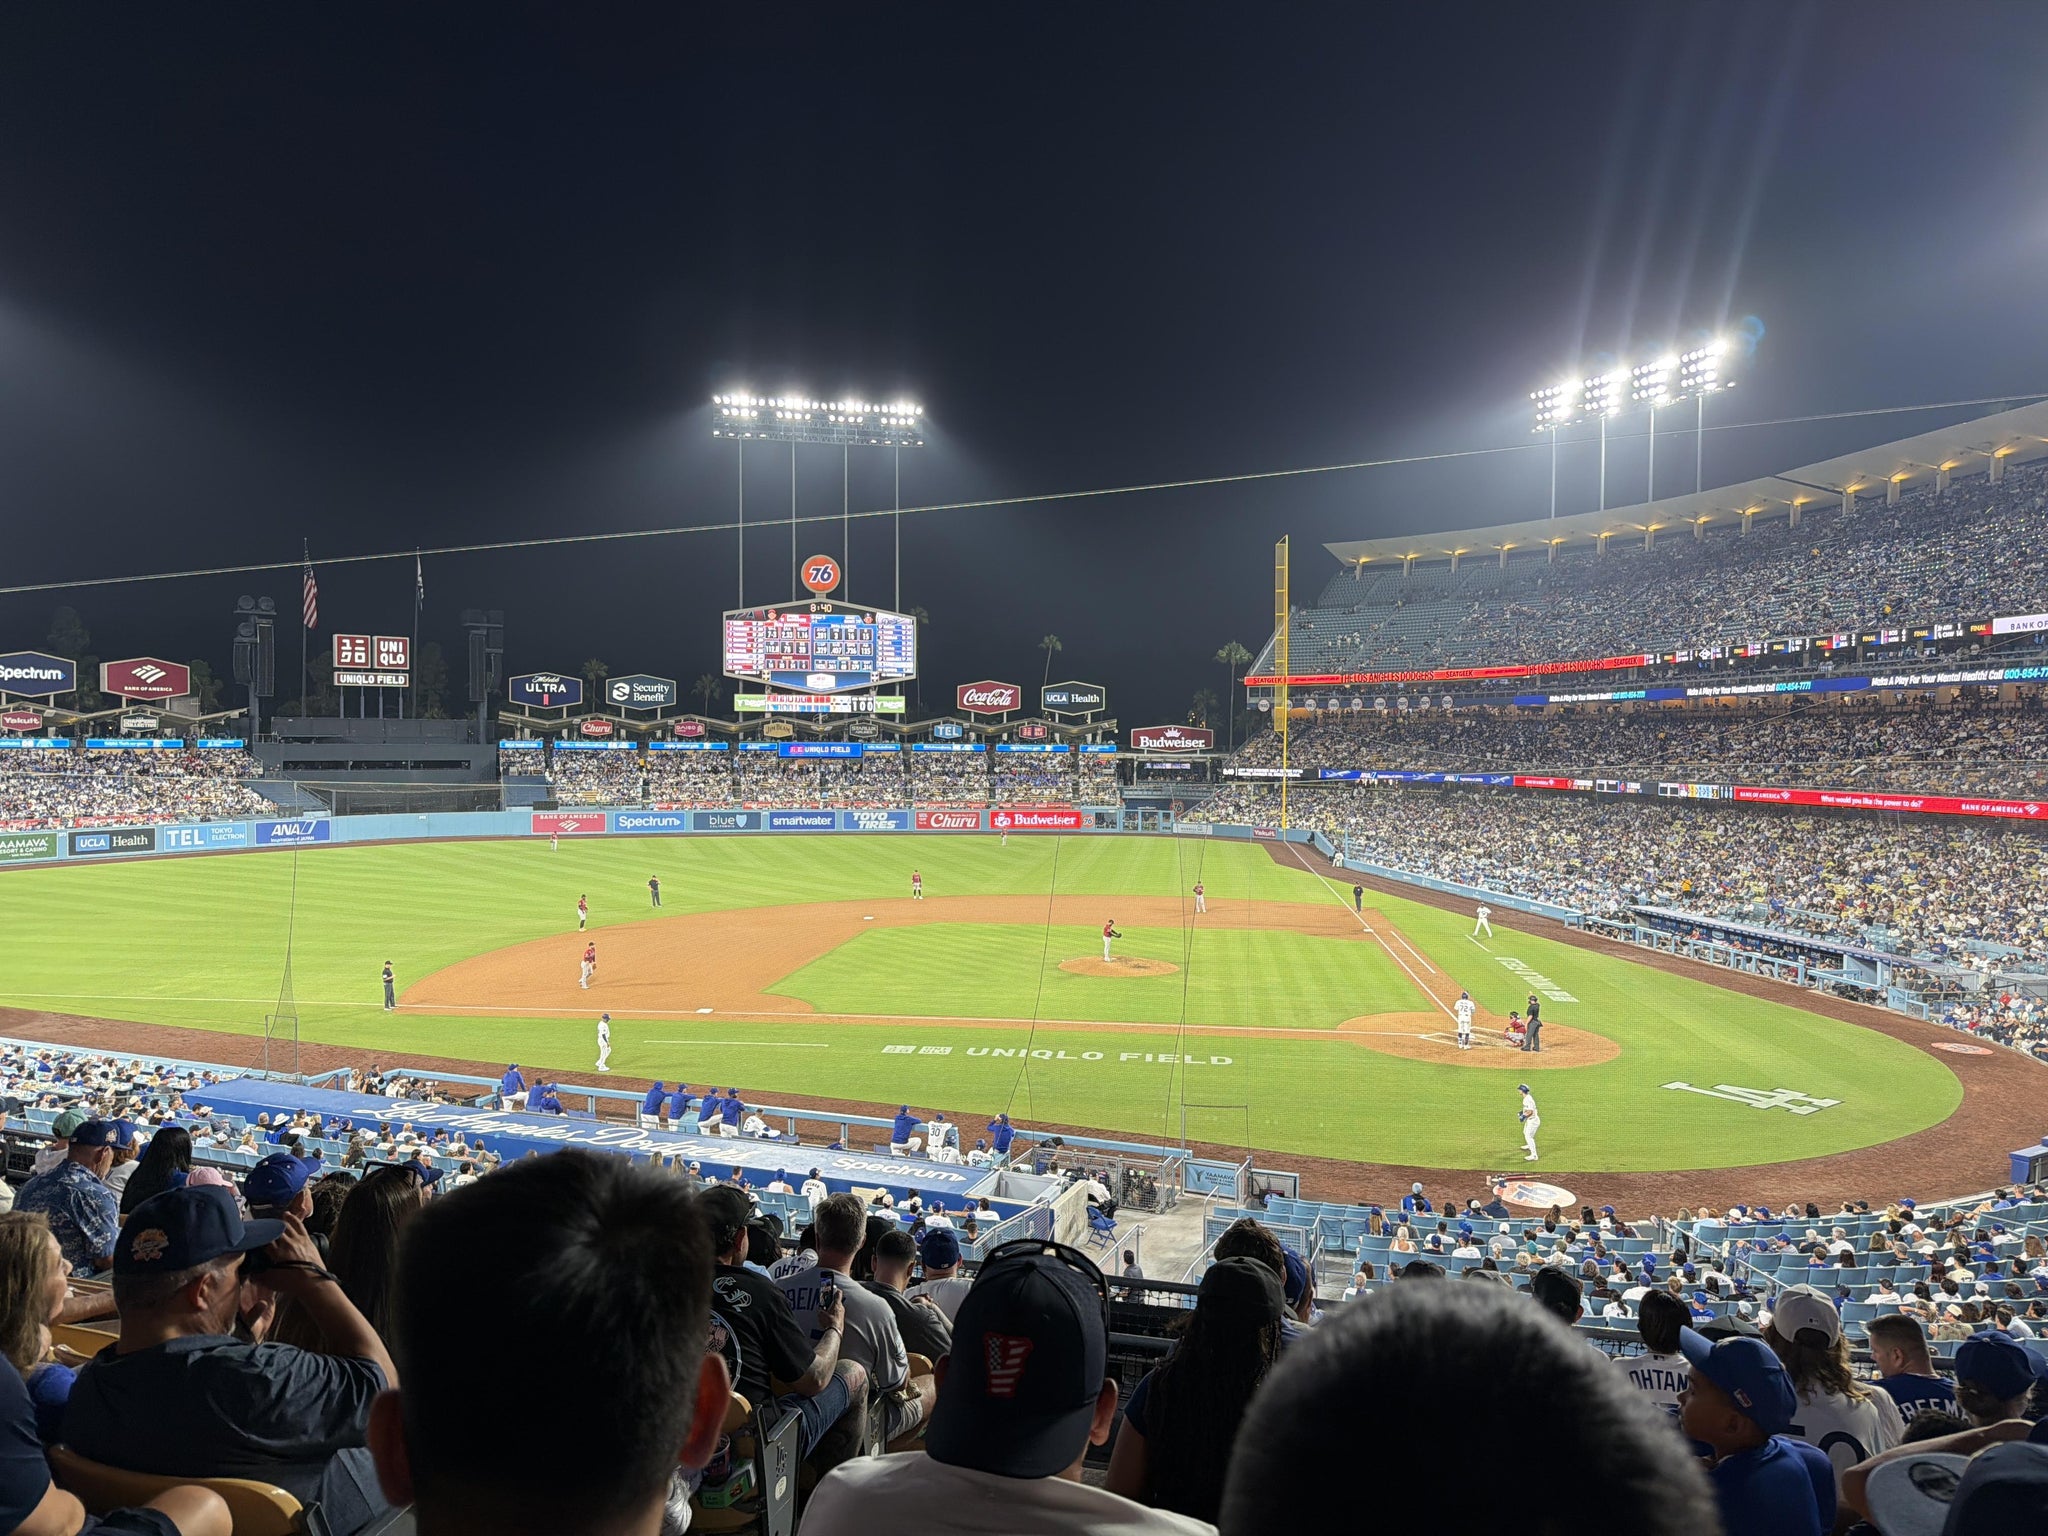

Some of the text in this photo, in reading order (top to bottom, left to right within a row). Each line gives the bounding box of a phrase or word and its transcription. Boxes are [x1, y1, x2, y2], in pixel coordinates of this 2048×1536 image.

[809, 564, 833, 584] 76
[810, 603, 832, 613] 8:40
[1970, 624, 1986, 632] FINAL
[2010, 620, 2048, 630] BANK OF
[380, 640, 403, 652] UNI
[380, 653, 405, 666] QLO
[1614, 655, 1638, 666] SEATGEEK
[1538, 664, 1550, 674] LOS
[1550, 662, 1577, 674] ANGELES
[1578, 660, 1604, 671] DODGERS
[0, 666, 62, 681] Spectrum
[1354, 672, 1367, 682] LOS
[1368, 672, 1400, 683] ANGELES
[1400, 670, 1434, 682] DODGERS
[1446, 670, 1473, 678] SEATGEEK
[1871, 668, 2004, 687] Make A Play For Your Mental Health! Call
[340, 674, 405, 685] UNIQLO FIELD
[526, 684, 566, 693] ULTRA
[633, 683, 670, 694] Security
[1703, 688, 1712, 696] Play
[1720, 686, 1731, 694] Your
[1765, 683, 1776, 692] Call
[633, 692, 665, 702] Benefit
[963, 688, 1014, 706] Coca-Cola
[1071, 694, 1100, 703] Health
[3, 716, 40, 725] Yakult
[582, 722, 612, 734] Churu
[938, 726, 959, 736] TEL
[1139, 736, 1206, 748] Budweiser
[1990, 804, 2023, 814] AMERICA
[709, 814, 735, 826] blue
[772, 816, 833, 826] smartwater
[852, 812, 888, 821] TOYO
[930, 814, 977, 828] Churu
[1014, 814, 1076, 825] Budweiser
[1082, 816, 1093, 825] 76
[618, 816, 677, 829] Spectrum
[858, 820, 896, 830] TIRES
[271, 824, 300, 836] ANA
[80, 834, 148, 848] UCLA Health
[166, 829, 204, 846] TEL
[212, 833, 244, 841] ELECTRON
[966, 1046, 1234, 1066] UNIQLO FIELD
[353, 1100, 757, 1162] Los Angeles Dodgers
[930, 1128, 940, 1137] 30
[832, 1157, 957, 1182] Spectrum
[806, 1188, 812, 1197] 5
[1629, 1368, 1690, 1393] OHTAN
